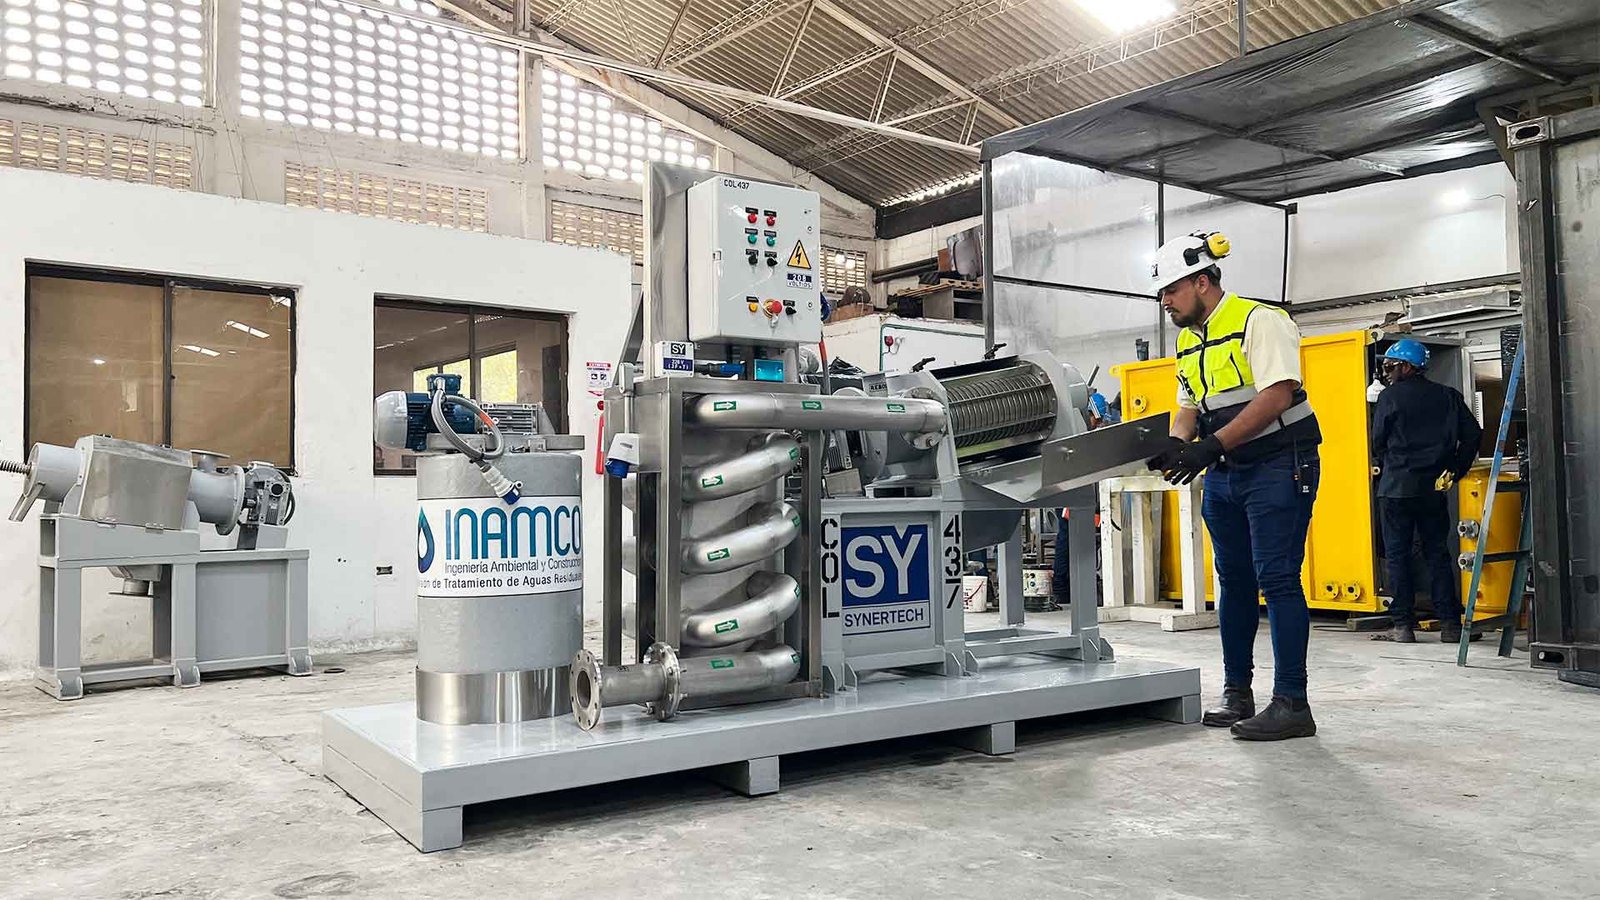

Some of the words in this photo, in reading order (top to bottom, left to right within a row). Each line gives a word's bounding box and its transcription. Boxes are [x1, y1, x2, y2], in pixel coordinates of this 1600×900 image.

[671, 344, 685, 354] SY
[445, 505, 581, 560] INAMCO
[490, 559, 539, 575] Ambiental
[540, 560, 547, 572] y
[820, 518, 840, 619] COL
[846, 534, 923, 598] SY
[943, 514, 962, 609] 437
[432, 579, 442, 588] de
[444, 577, 503, 588] Tratamiento
[506, 576, 519, 587] de
[522, 575, 552, 588] Aguas
[844, 607, 924, 628] SYNERTECH
